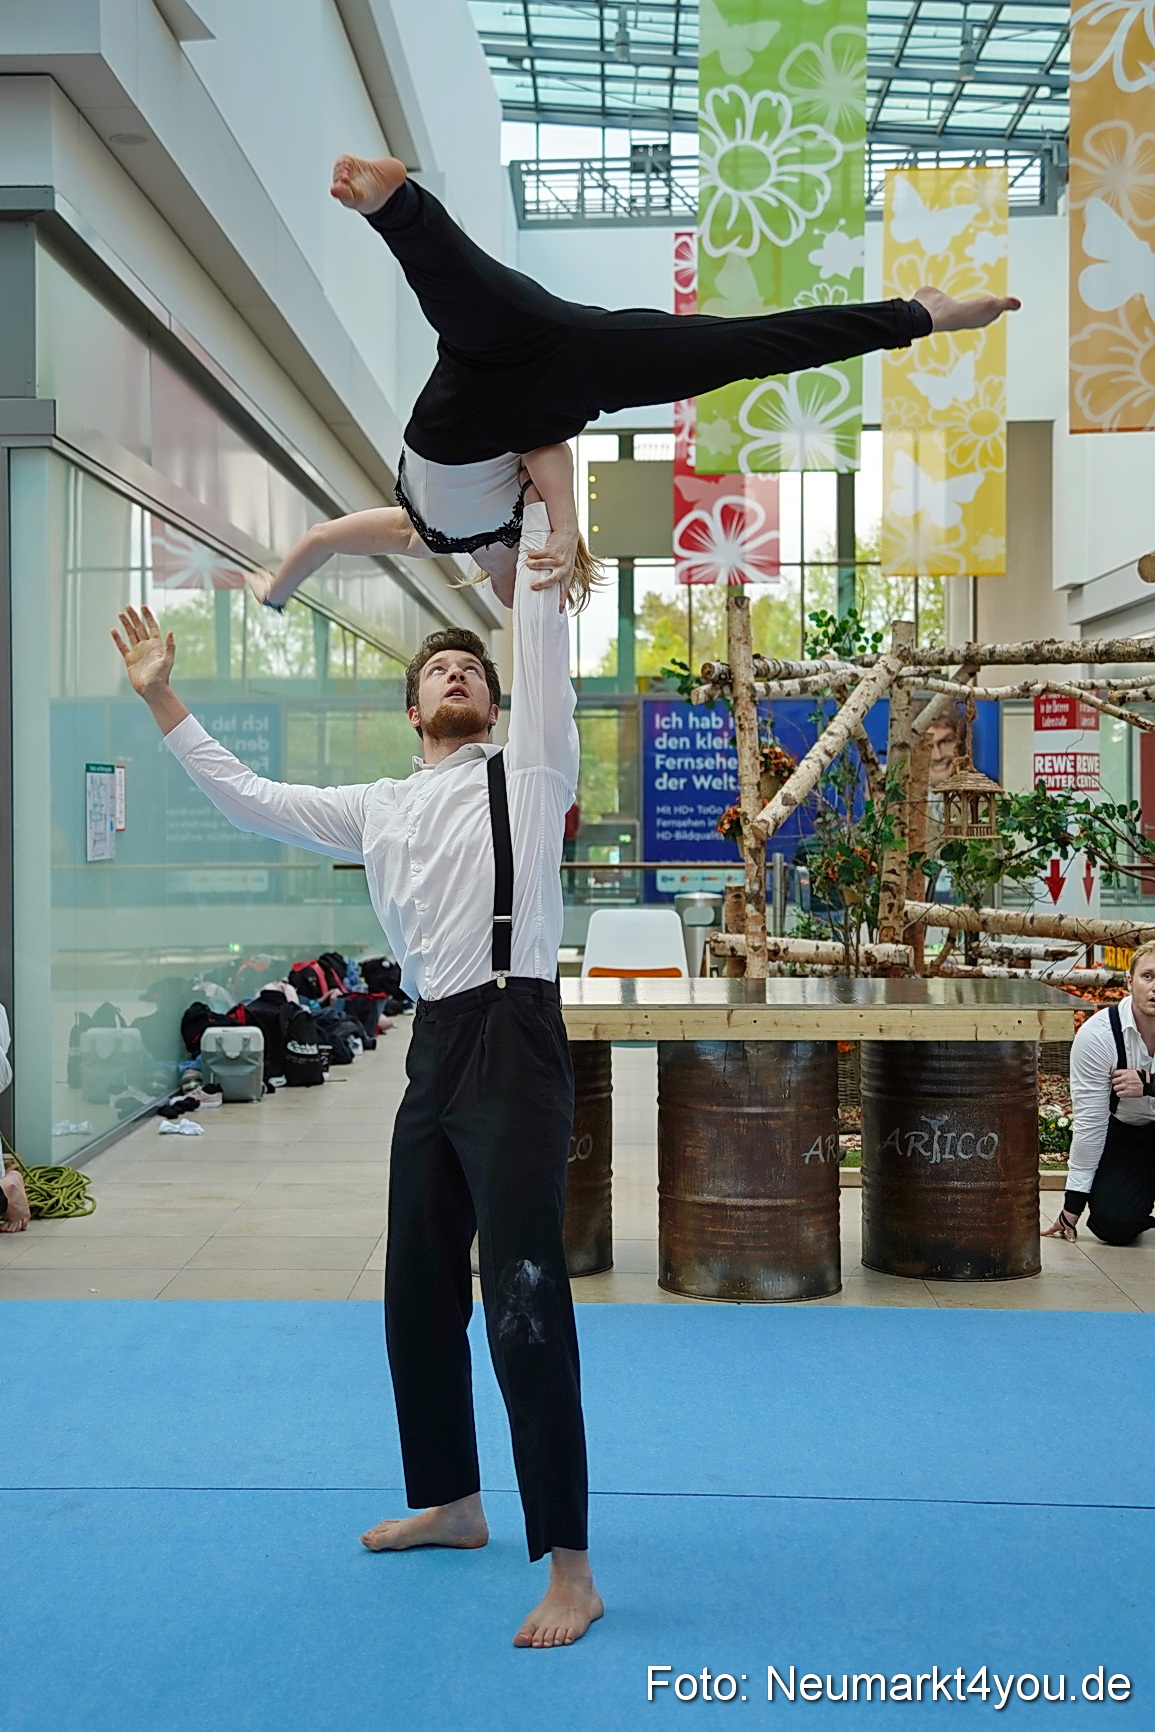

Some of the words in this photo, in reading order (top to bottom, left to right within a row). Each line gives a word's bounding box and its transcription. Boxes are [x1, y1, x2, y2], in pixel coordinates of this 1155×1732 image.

[655, 711, 683, 730] Ich
[688, 711, 724, 730] hab
[654, 732, 691, 750] den
[696, 731, 736, 750] klei
[655, 752, 738, 770] Fernsehe
[1034, 754, 1075, 773] REWE
[1076, 754, 1099, 773] REWE
[654, 772, 688, 791] der
[656, 804, 672, 814] Mit
[697, 804, 723, 815] ToGo
[656, 818, 706, 828] Fernsehen
